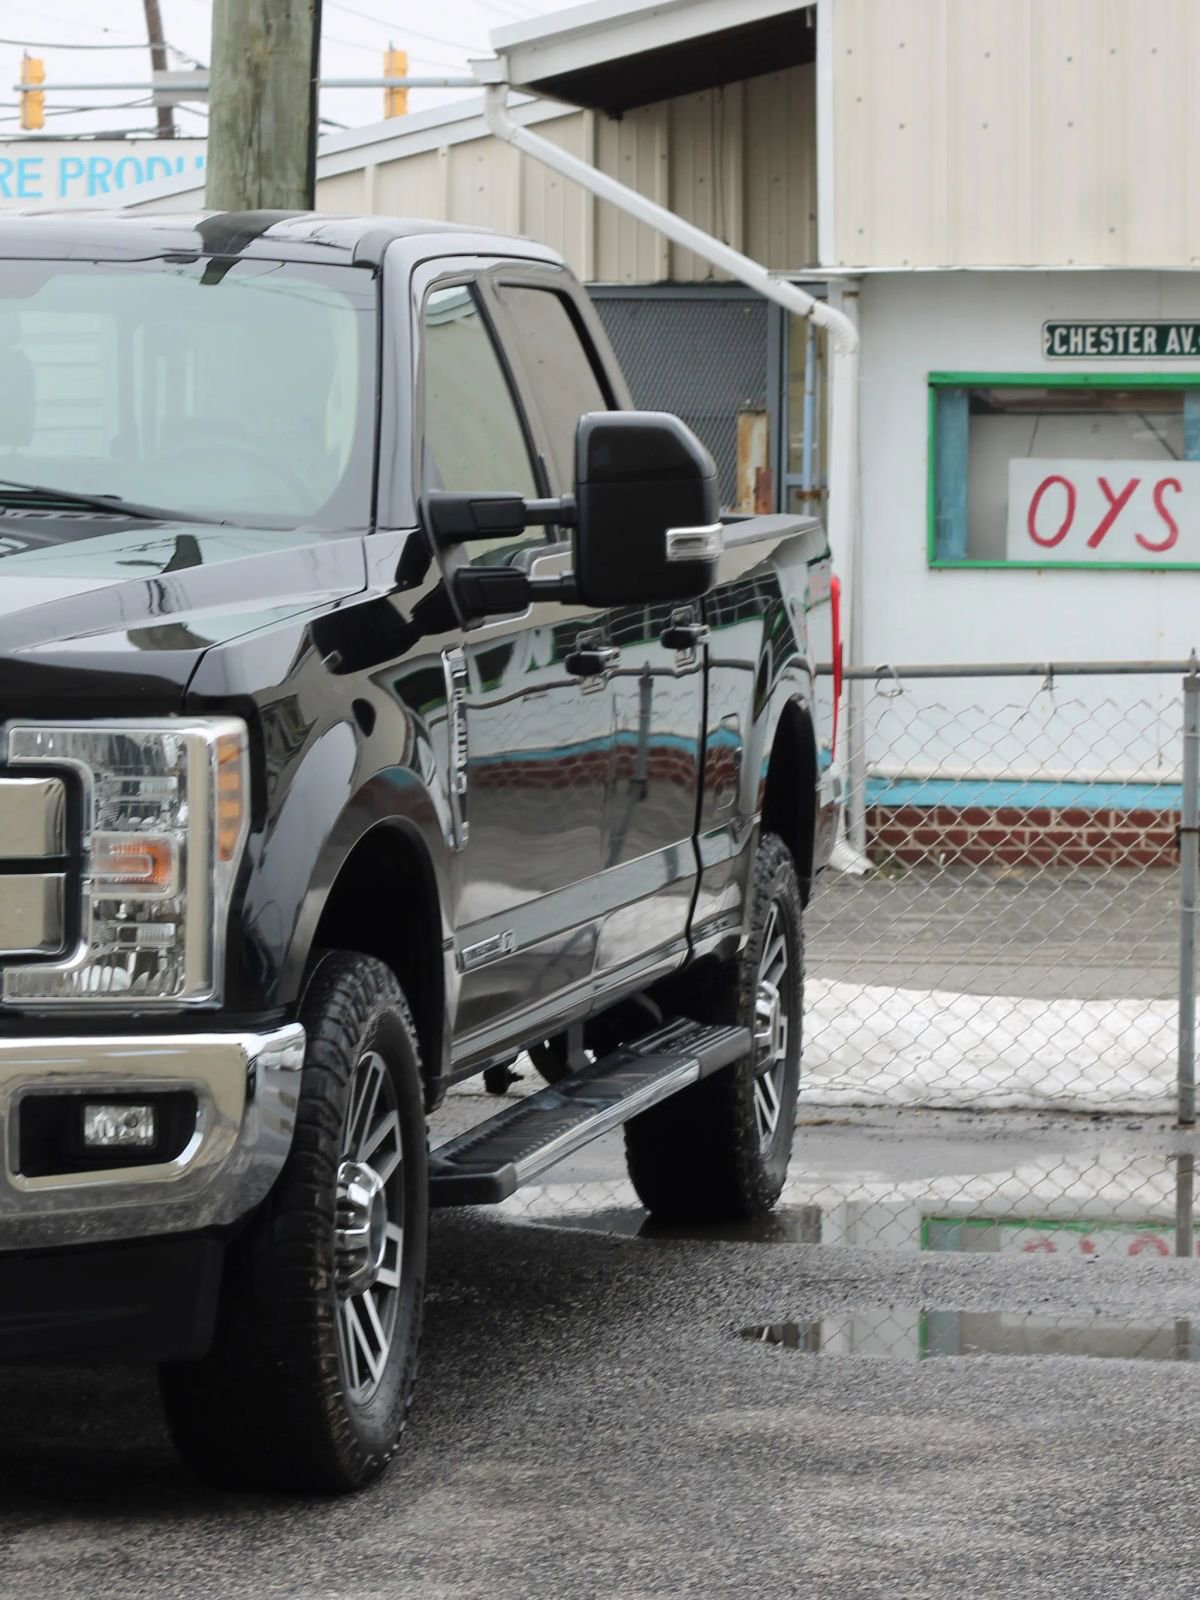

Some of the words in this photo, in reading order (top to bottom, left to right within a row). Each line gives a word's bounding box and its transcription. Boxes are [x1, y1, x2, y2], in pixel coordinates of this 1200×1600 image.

[1053, 326, 1157, 354] CHESTER
[1165, 326, 1197, 354] AV.
[1027, 474, 1183, 552] OYS
